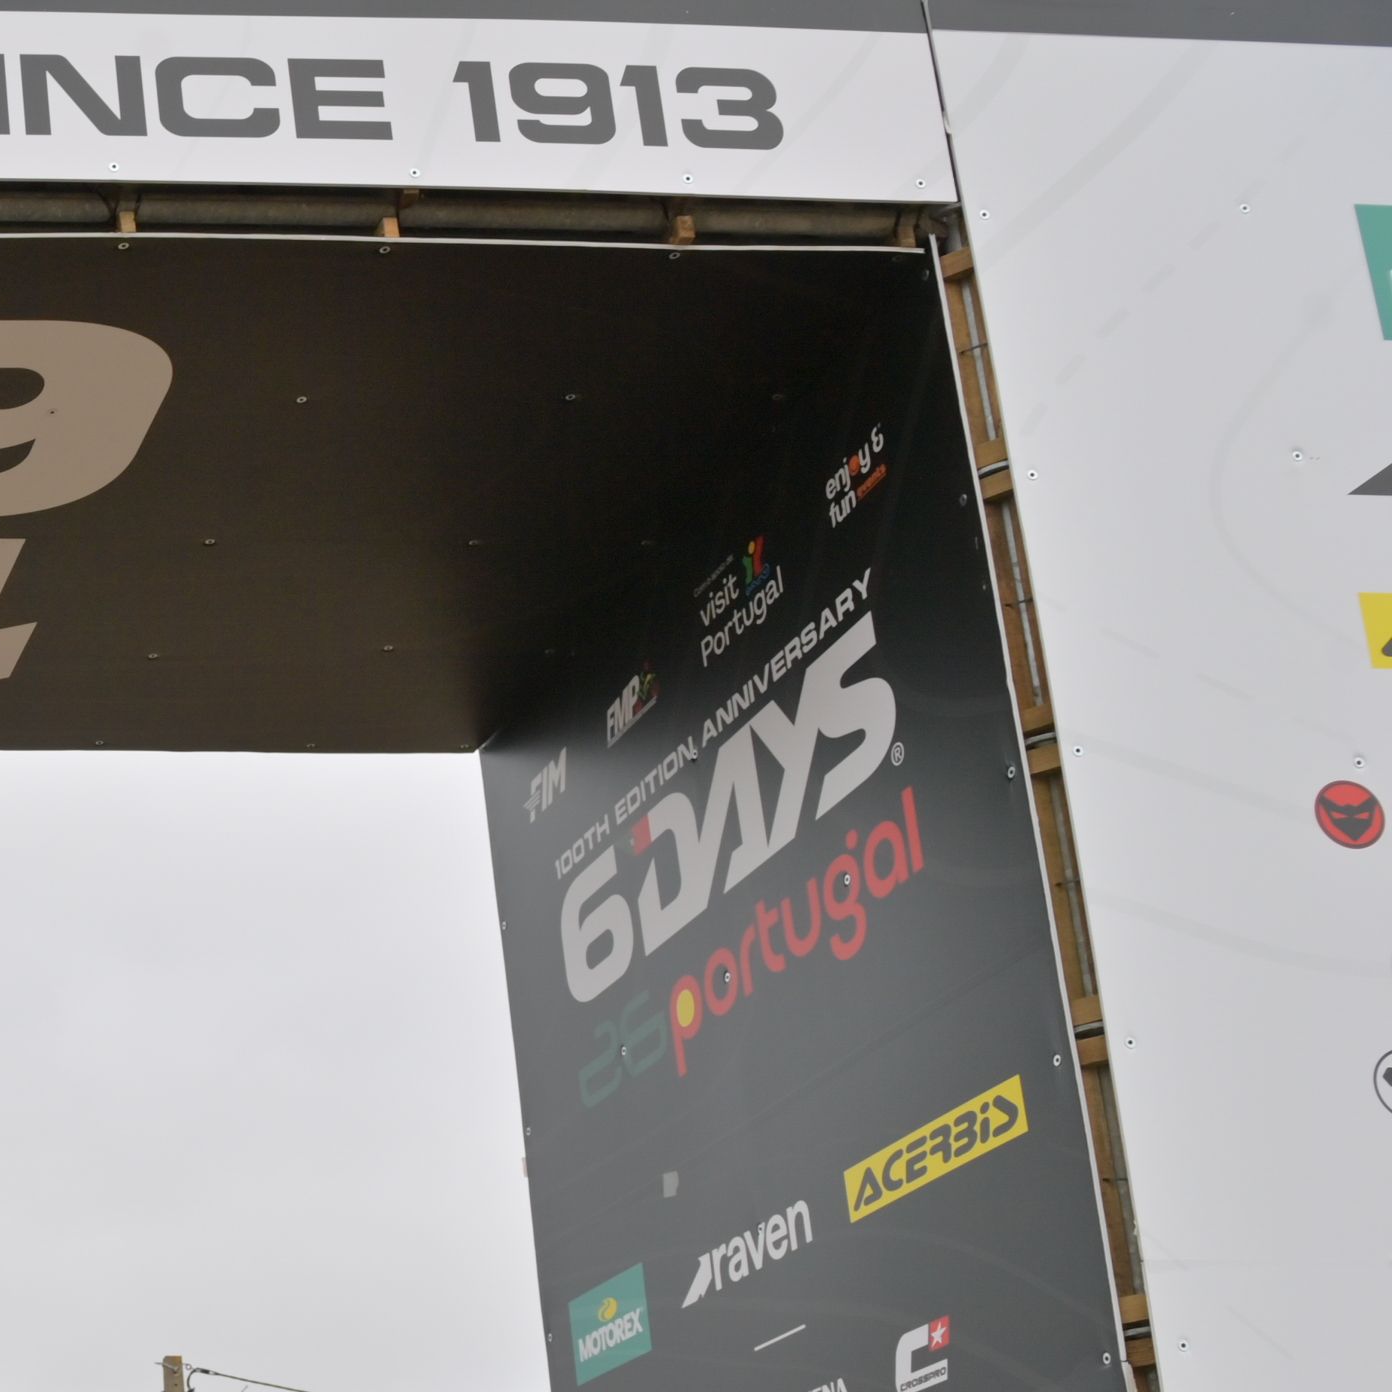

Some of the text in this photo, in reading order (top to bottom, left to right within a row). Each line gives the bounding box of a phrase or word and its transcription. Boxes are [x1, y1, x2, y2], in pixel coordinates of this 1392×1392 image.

[451, 60, 785, 151] 1913
[829, 489, 857, 528] fun
[699, 573, 740, 627] visit
[700, 565, 783, 668] Portugal
[554, 814, 610, 880] 100TH
[615, 738, 696, 826] EDITION
[701, 568, 872, 750] ANNIVERSARY
[607, 674, 641, 748] FMP
[525, 747, 567, 823] FIM
[560, 610, 897, 1003] 6DAYS
[669, 786, 925, 1078] portugal
[711, 1200, 813, 1291] raven
[578, 1309, 643, 1363] MOTOREX
[899, 1366, 947, 1392] CROSSPRO
